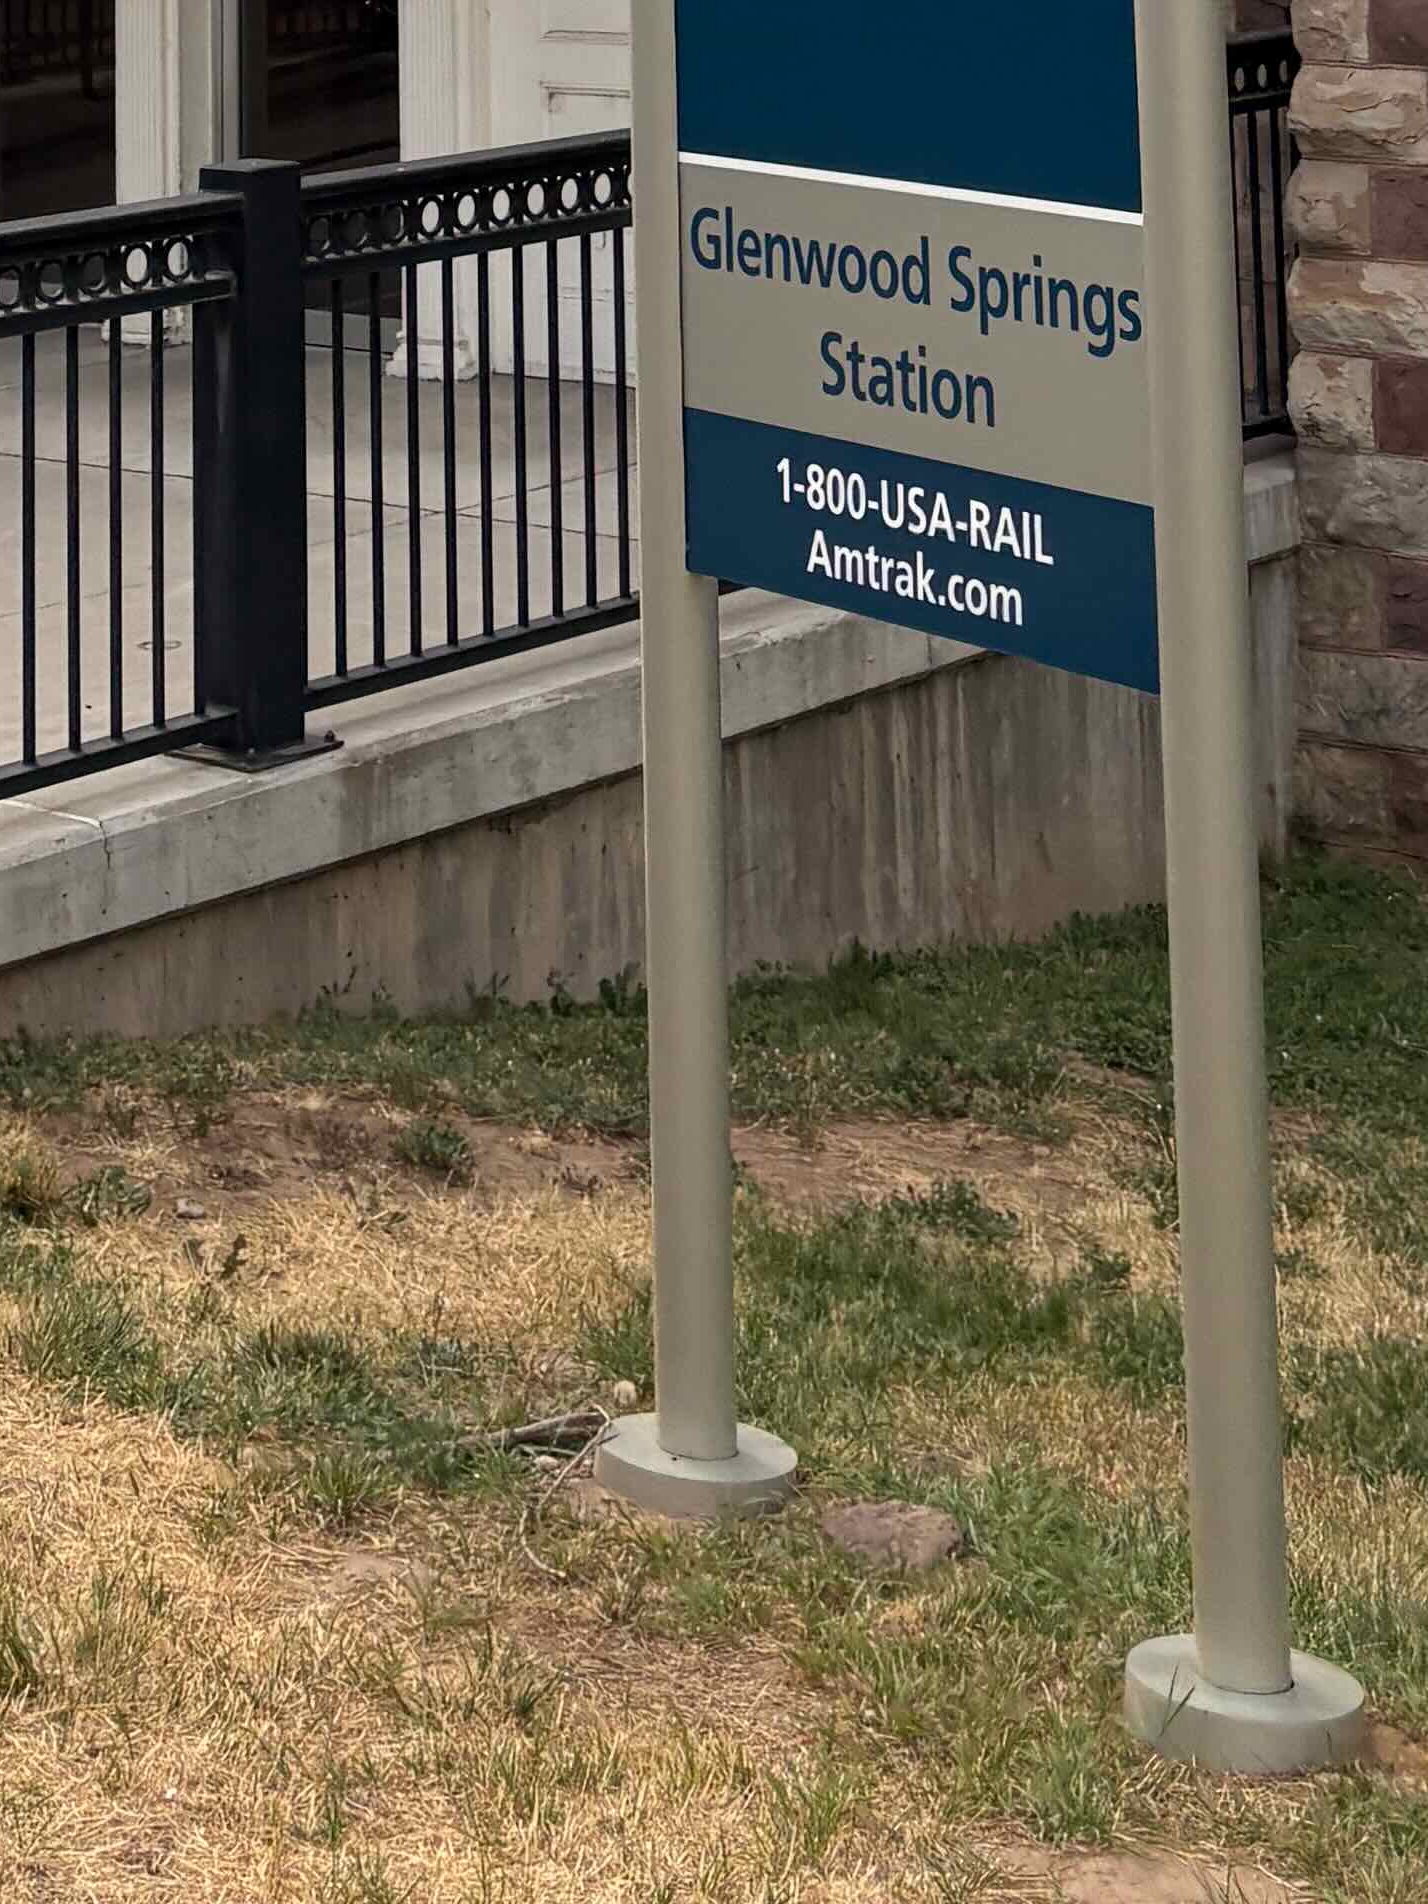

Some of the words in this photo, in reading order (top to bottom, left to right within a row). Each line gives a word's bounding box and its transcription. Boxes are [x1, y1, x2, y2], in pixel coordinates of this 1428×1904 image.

[690, 205, 931, 306] Glenwood
[948, 244, 1142, 358] Springs
[819, 330, 996, 428] Station
[776, 456, 1055, 566] 1-800-USA-RAIL
[806, 528, 1023, 627] Amtrak.com
